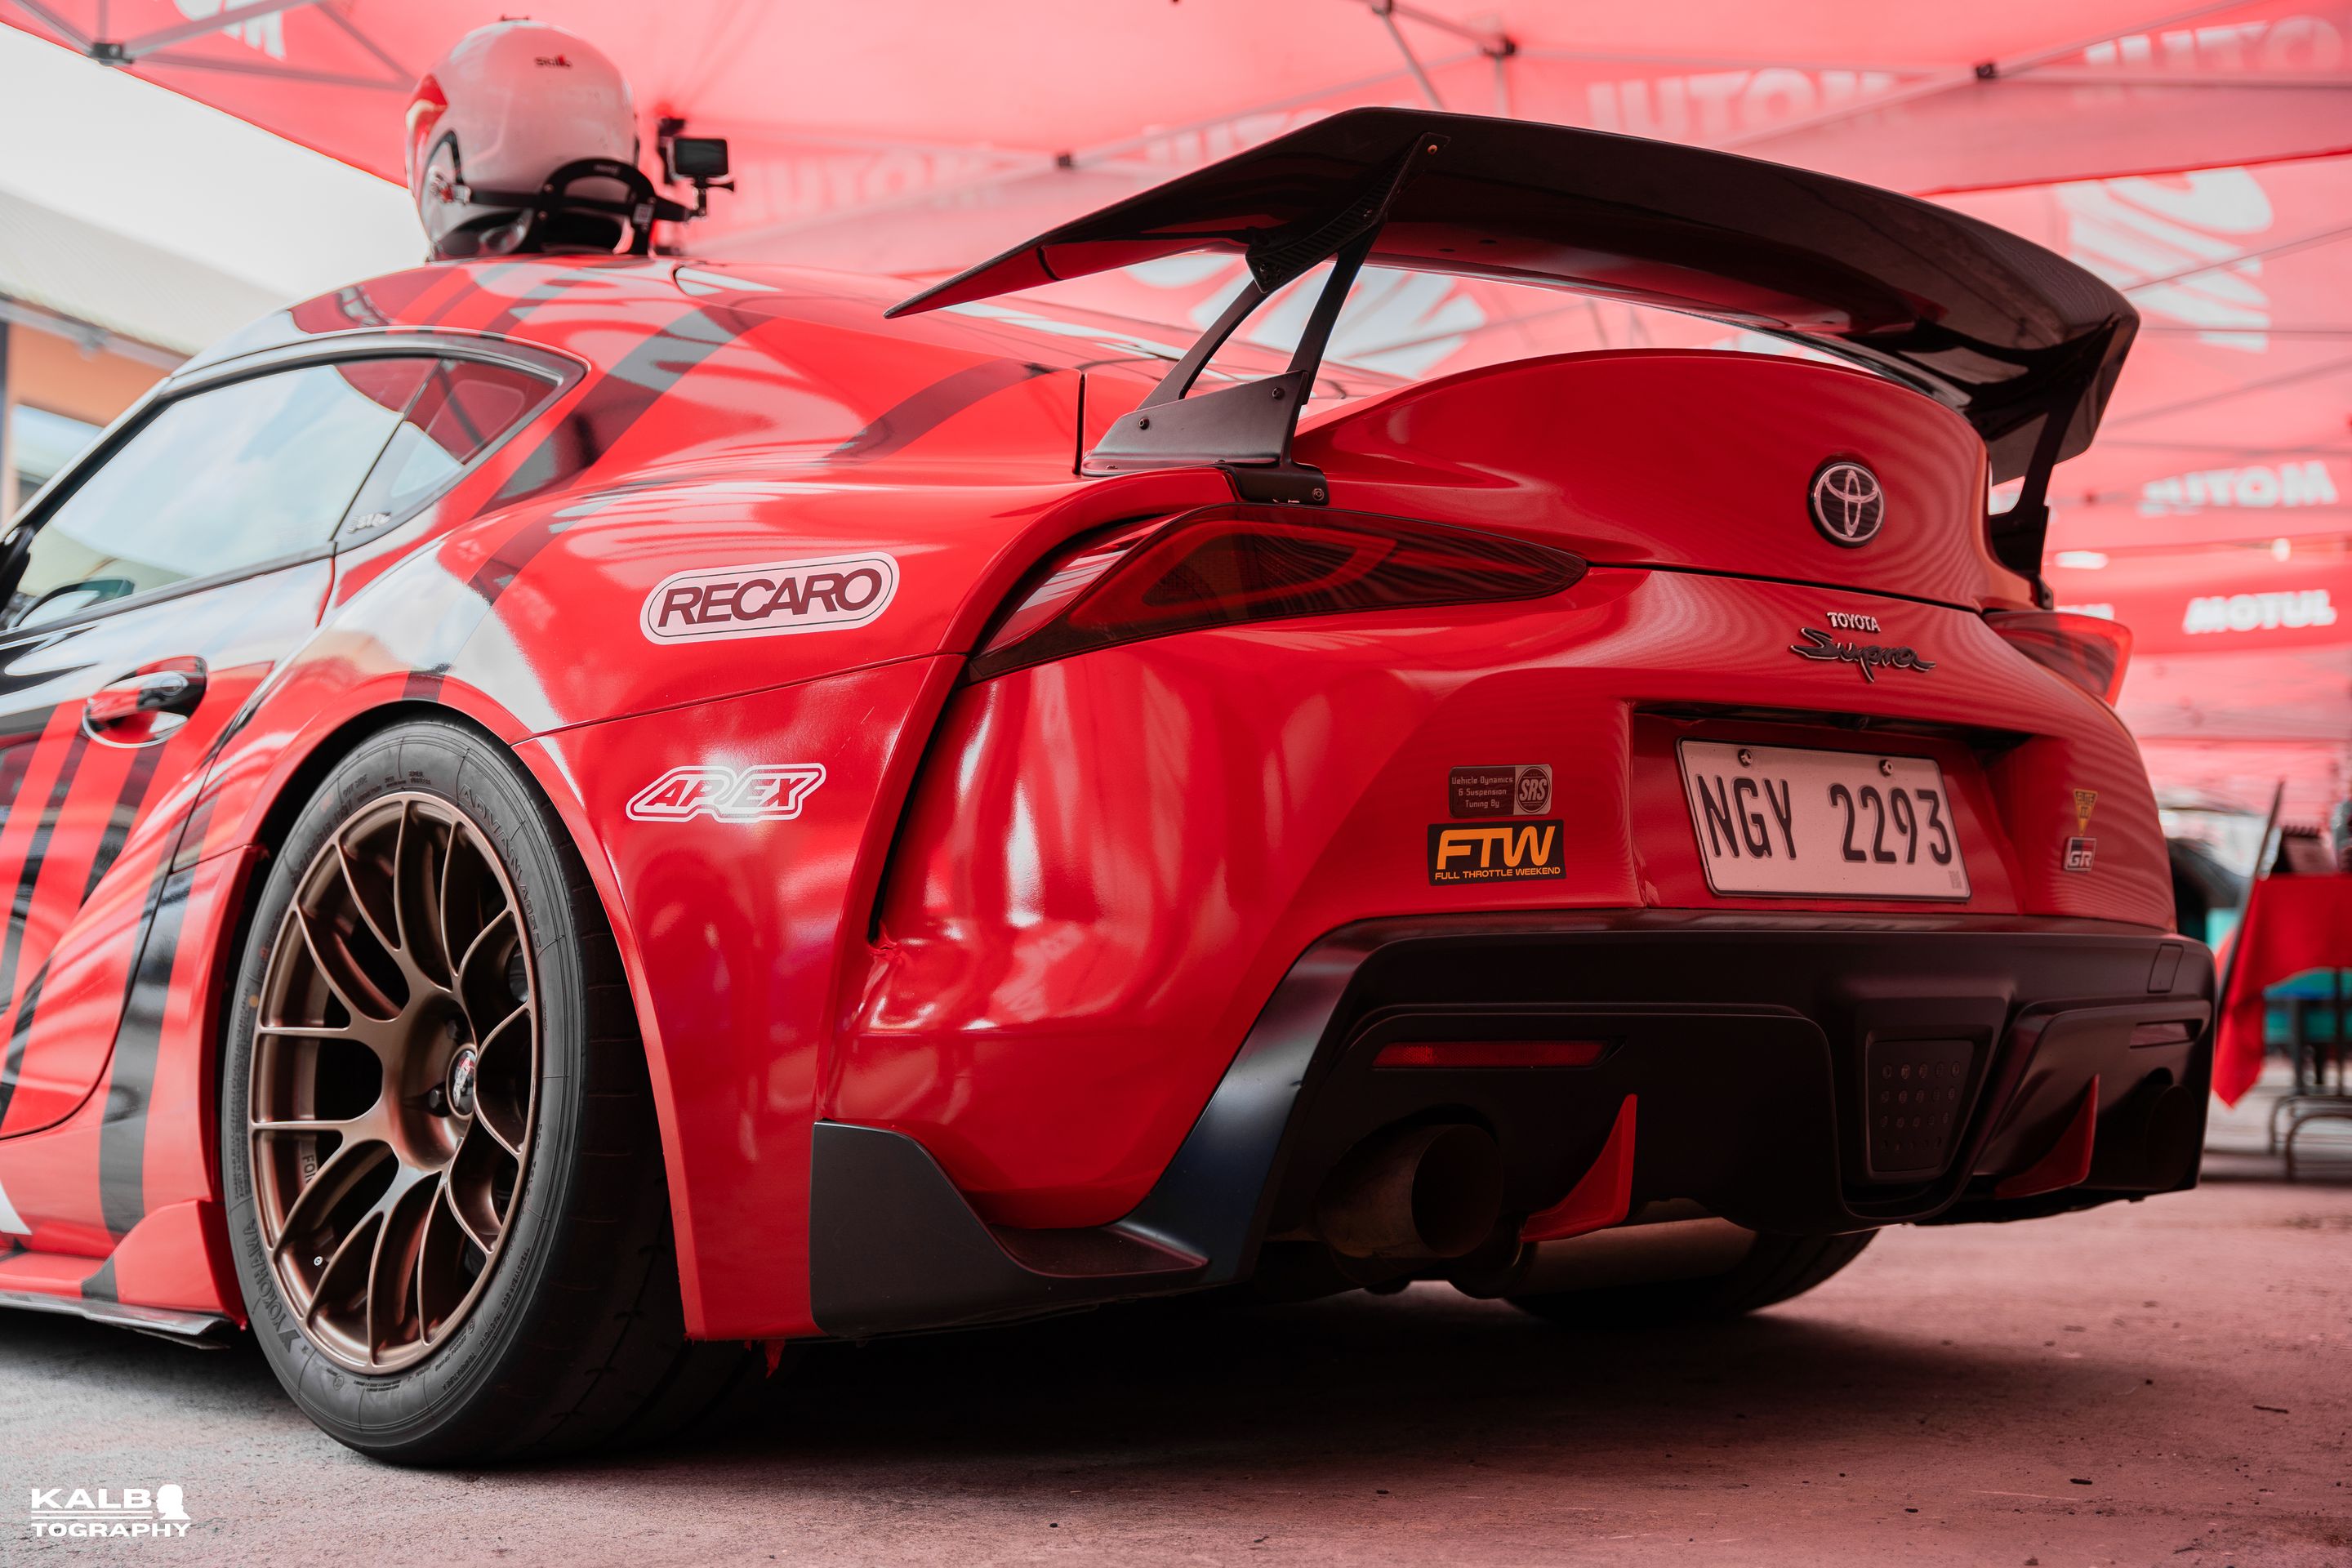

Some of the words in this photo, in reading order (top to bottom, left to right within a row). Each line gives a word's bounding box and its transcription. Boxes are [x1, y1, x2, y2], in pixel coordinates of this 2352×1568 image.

[657, 568, 883, 628] RECARO
[2183, 589, 2337, 635] MOTUL
[1827, 612, 1881, 632] TOYOTA
[1789, 627, 1937, 684] Supra
[637, 773, 817, 811] APEX
[1451, 777, 1477, 785] Vehicle
[1480, 776, 1513, 785] Dynamics
[1466, 788, 1507, 796] Suspension
[1519, 778, 1548, 800] SRS
[1465, 800, 1488, 808] Tuning
[1491, 800, 1499, 808] By
[1696, 774, 1797, 859] NGY
[1828, 783, 1953, 865] 2293
[459, 784, 522, 881] ADVAN
[1437, 826, 1556, 870] FTW
[1463, 869, 1512, 878] THROTTLE
[1516, 867, 1561, 875] WEEKEND
[2069, 851, 2092, 867] GR
[243, 1218, 287, 1332] YOKOHAMA
